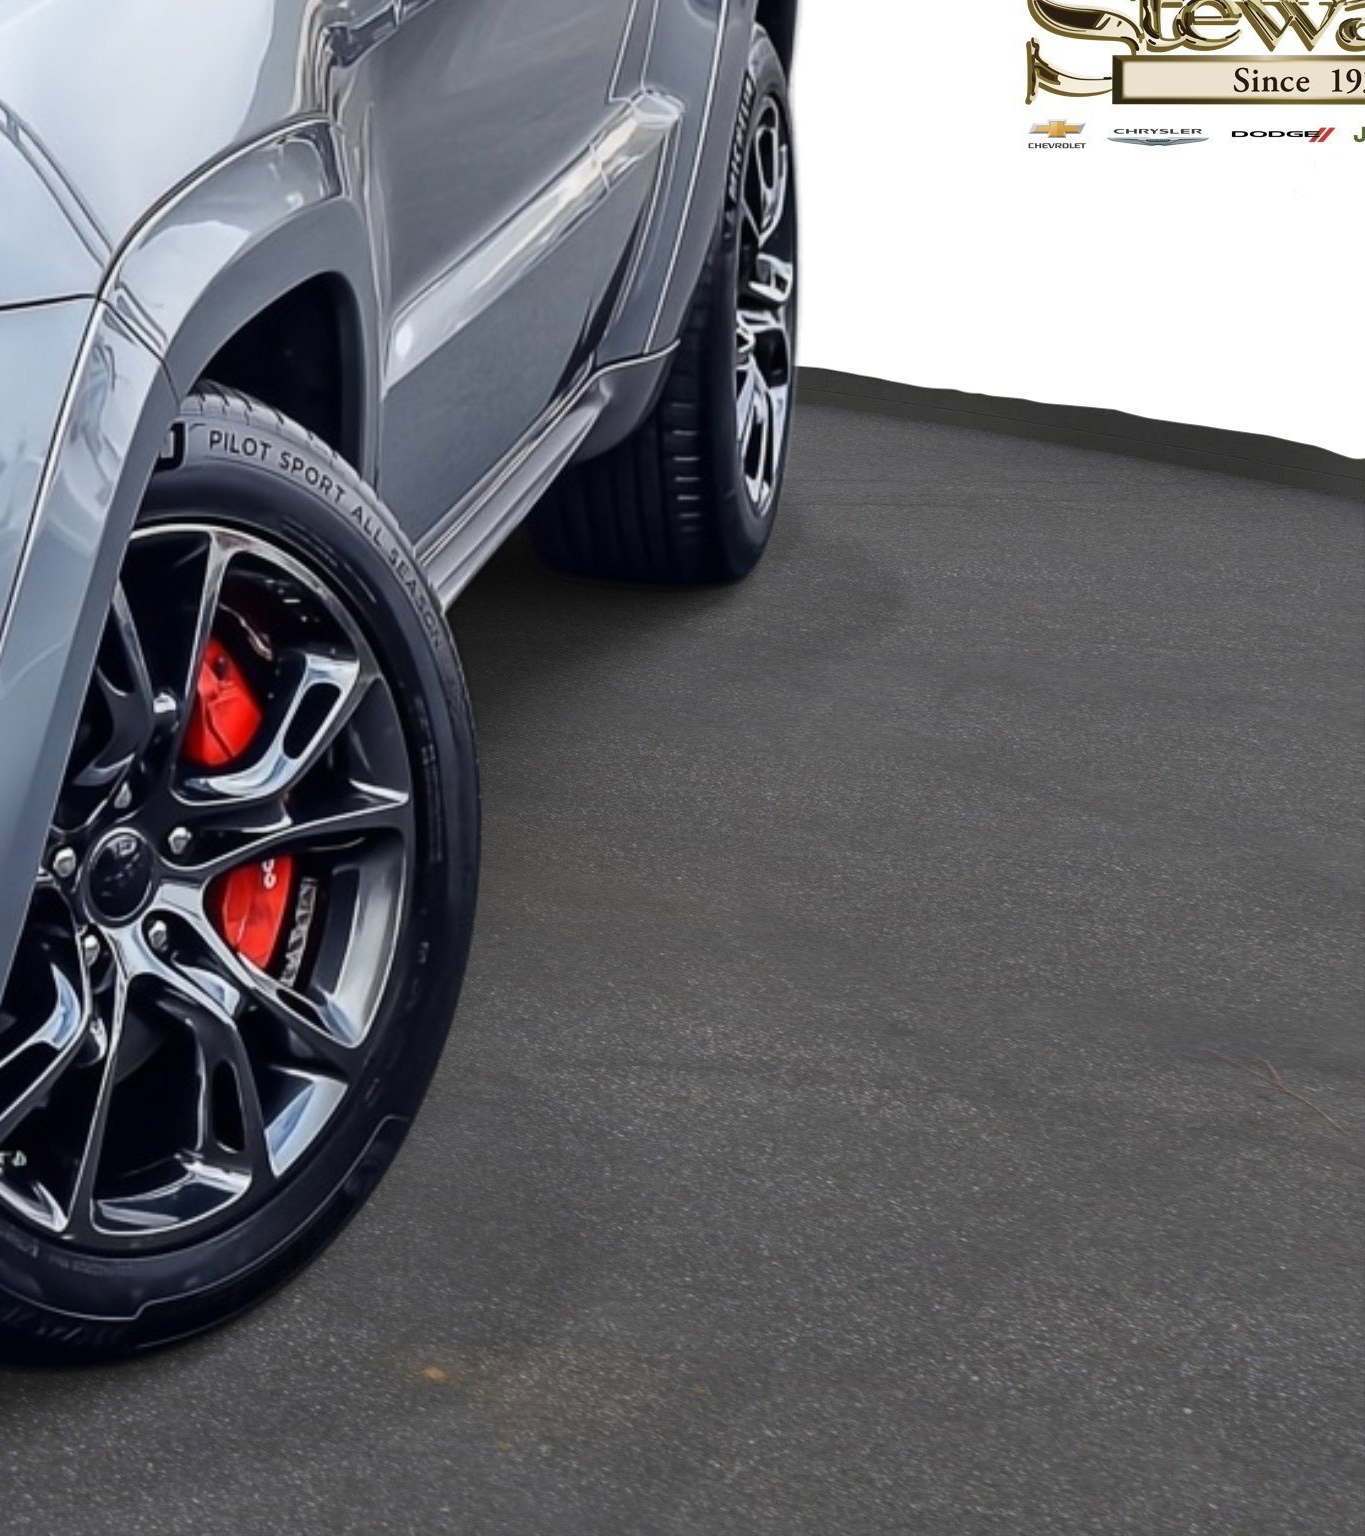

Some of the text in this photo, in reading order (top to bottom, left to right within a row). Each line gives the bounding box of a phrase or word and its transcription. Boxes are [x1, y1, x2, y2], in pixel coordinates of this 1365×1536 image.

[1233, 67, 1365, 95] Since 19
[209, 430, 272, 462] PILOT
[278, 451, 346, 504] SPORT
[351, 505, 383, 547] ALL
